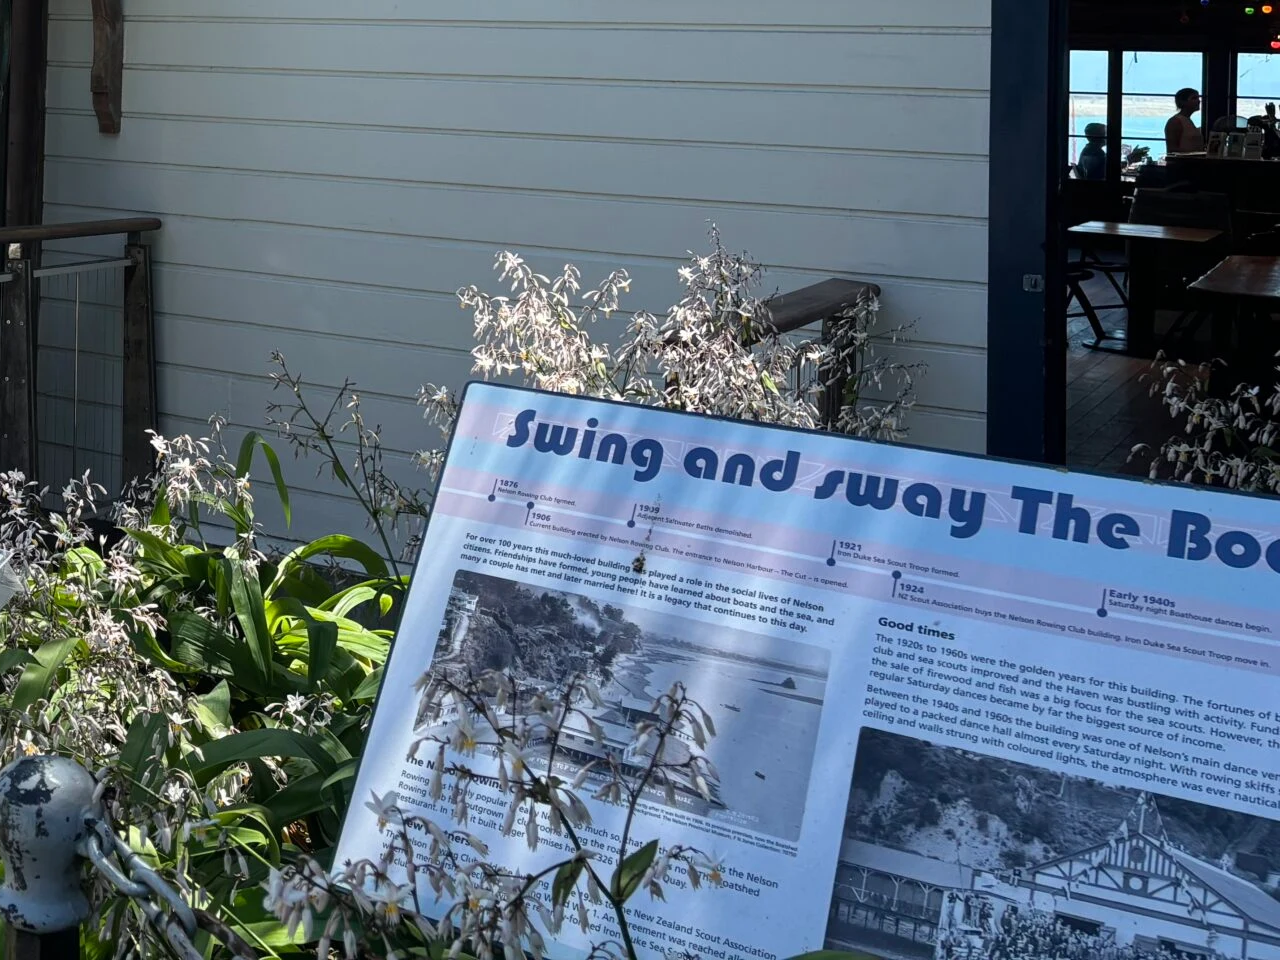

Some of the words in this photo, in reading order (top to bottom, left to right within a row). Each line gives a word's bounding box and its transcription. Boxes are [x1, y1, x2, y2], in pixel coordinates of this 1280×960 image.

[500, 479, 519, 489] 1876
[506, 409, 665, 482] Swing
[683, 446, 801, 492] and
[813, 469, 987, 540] sway
[1011, 485, 1141, 550] The
[531, 512, 552, 522] 1906
[839, 541, 862, 552] 1921
[462, 542, 493, 555] citizens.
[494, 548, 537, 564] Friendships
[538, 556, 558, 568] have
[558, 561, 589, 575] formed,
[590, 569, 617, 582] young
[618, 575, 647, 589] people
[648, 579, 670, 592] have
[670, 584, 704, 599] learned
[704, 592, 732, 605] about
[732, 597, 758, 610] boats
[758, 604, 778, 614] and
[779, 607, 795, 618] the
[796, 612, 814, 623] sea,
[816, 616, 835, 626] and
[479, 536, 497, 545] over
[511, 543, 534, 553] years
[534, 546, 550, 556] this
[550, 550, 597, 565] much-loved
[597, 558, 631, 574] building
[647, 569, 678, 582] played
[685, 578, 703, 587] role
[715, 582, 730, 593] the
[731, 587, 757, 598] social
[757, 591, 779, 603] lives
[792, 598, 825, 613] Nelson
[460, 553, 482, 564] many
[488, 559, 514, 570] couple
[514, 563, 529, 573] has
[530, 567, 547, 577] met
[546, 571, 563, 580] and
[563, 572, 583, 584] later
[583, 579, 616, 591] married
[616, 584, 639, 596] here!
[664, 594, 692, 609] legacy
[693, 601, 712, 612] that
[713, 606, 757, 621] continues
[770, 617, 787, 628] this
[788, 621, 808, 634] day.
[899, 582, 925, 594] 1924
[1108, 589, 1140, 605] Early
[1142, 595, 1176, 608] 1940s
[1108, 598, 1145, 613] Saturday
[1145, 606, 1168, 616] night
[1168, 609, 1213, 623] Boathouse
[1214, 617, 1244, 629] dances
[1244, 622, 1272, 634] begin.
[878, 616, 915, 633] Good
[917, 624, 955, 641] times
[872, 645, 894, 657] club
[896, 651, 916, 661] and
[917, 655, 935, 665] sea
[937, 660, 968, 673] scouts
[970, 665, 1020, 683] improved
[1020, 672, 1043, 688] and
[1045, 679, 1064, 692] the
[1065, 684, 1100, 700] Haven
[1102, 694, 1124, 705] was
[1126, 696, 1172, 716] bustling
[1174, 708, 1200, 720] with
[1203, 714, 1246, 731] activity.
[875, 633, 894, 645] The
[896, 637, 924, 651] 1920s
[940, 646, 968, 660] 1960s
[970, 654, 997, 666] were
[998, 658, 1017, 670] the
[1018, 664, 1056, 678] golden
[1057, 672, 1086, 684] years
[1088, 676, 1105, 688] for
[1107, 681, 1128, 692] this
[1130, 684, 1179, 704] building.
[1182, 694, 1204, 708] The
[1206, 699, 1255, 718] fortunes
[1257, 710, 1272, 721] of
[871, 656, 888, 668] the
[889, 662, 910, 673] sale
[926, 667, 973, 686] firewood
[974, 680, 996, 691] and
[998, 683, 1017, 695] fish
[1019, 689, 1041, 700] was
[1052, 694, 1071, 709] big
[1073, 698, 1102, 713] focus
[1105, 705, 1122, 717] for
[1125, 710, 1144, 722] the
[1146, 715, 1165, 726] sea
[1168, 720, 1206, 735] scouts.
[1209, 726, 1263, 748] However,
[397, 780, 428, 798] Rowing
[400, 769, 431, 787] Rowing
[474, 793, 509, 808] popular
[477, 816, 498, 830] built
[584, 820, 609, 838] much
[728, 867, 745, 879] the
[746, 872, 779, 889] Nelson
[633, 908, 655, 923] New
[655, 915, 694, 935] Zealand
[694, 928, 721, 945] Scout
[722, 937, 777, 960] Association
[668, 935, 687, 947] was
[688, 941, 726, 960] reached
